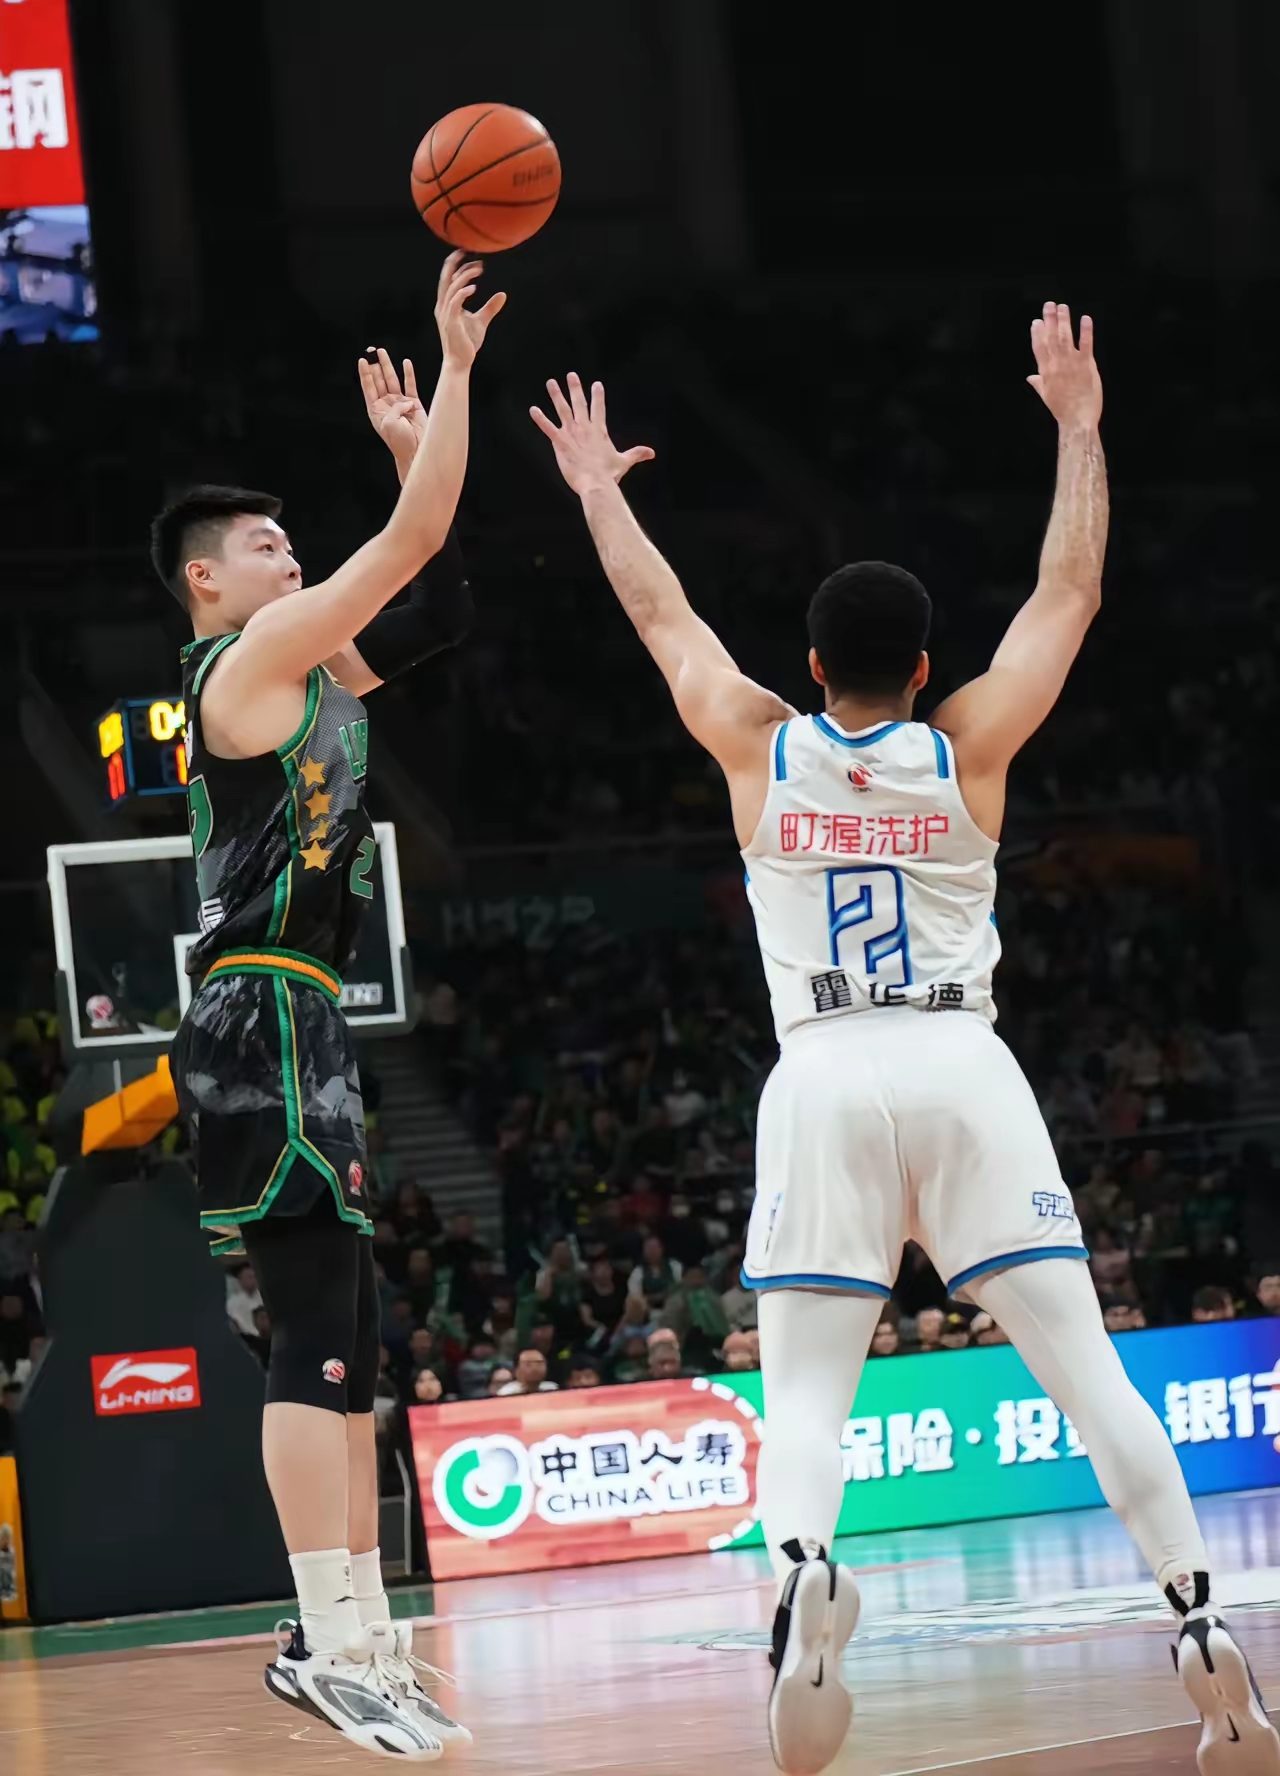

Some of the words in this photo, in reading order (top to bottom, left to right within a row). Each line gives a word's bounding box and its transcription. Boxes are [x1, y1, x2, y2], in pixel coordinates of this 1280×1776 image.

[780, 813, 949, 855] 町渥洗护
[824, 864, 914, 988] 2
[100, 1385, 194, 1409] LI-NING
[541, 1432, 733, 1483] 中国人寿
[547, 1486, 654, 1513] CHINA
[668, 1476, 738, 1500] LIFE
